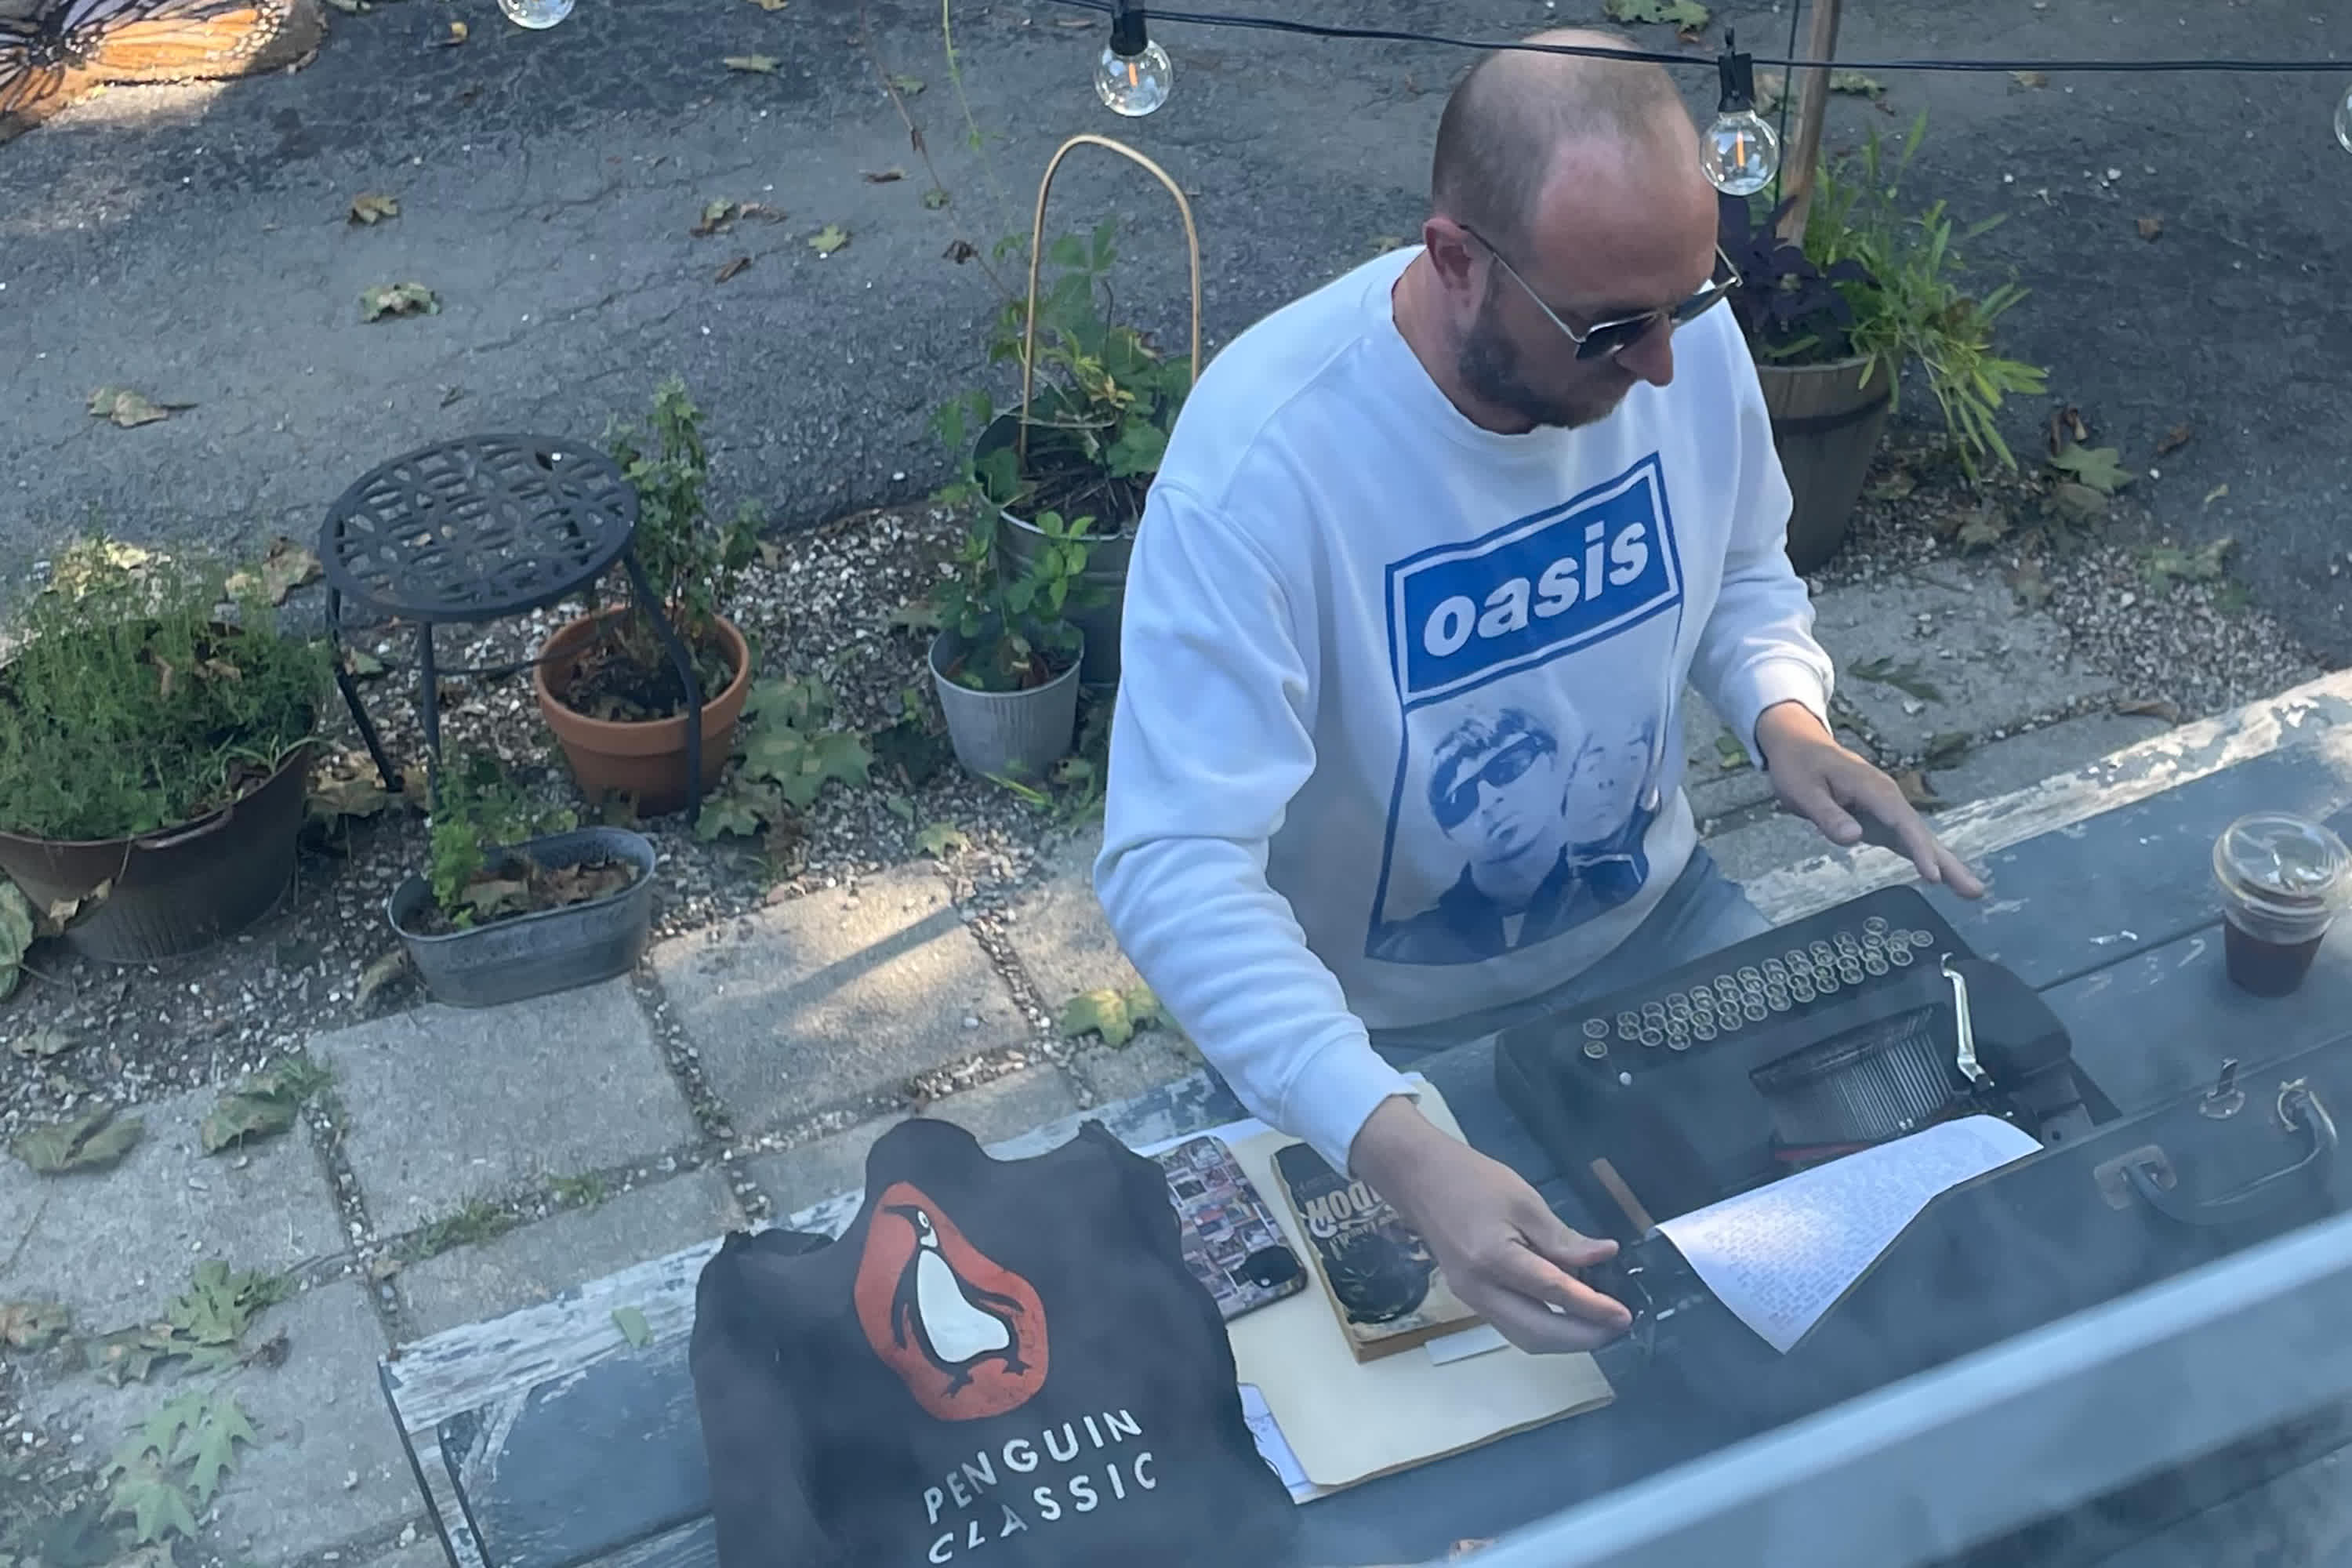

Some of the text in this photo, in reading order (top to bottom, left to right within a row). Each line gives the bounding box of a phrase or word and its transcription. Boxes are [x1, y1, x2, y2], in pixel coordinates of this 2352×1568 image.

[1423, 520, 1648, 658] oasis
[923, 1409, 1142, 1524] PENGUIN
[928, 1451, 1157, 1564] CLASSIC
